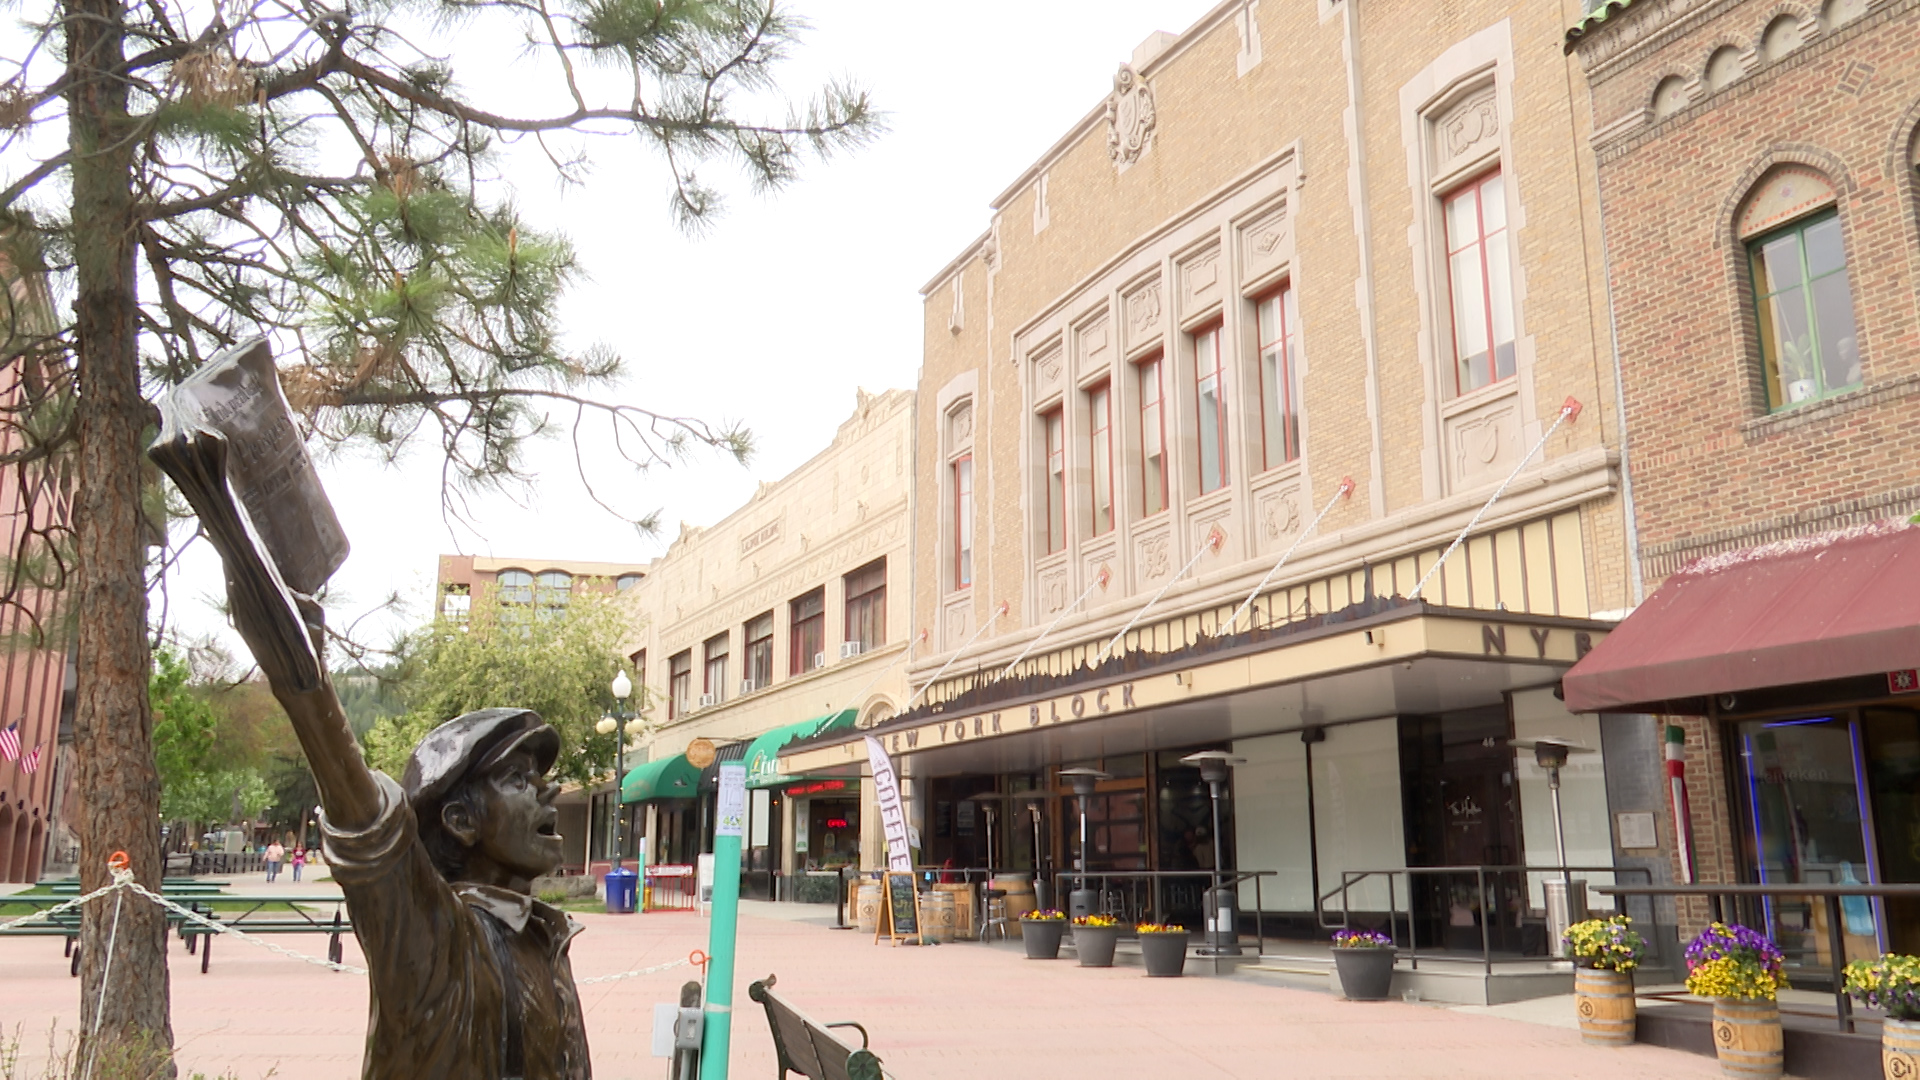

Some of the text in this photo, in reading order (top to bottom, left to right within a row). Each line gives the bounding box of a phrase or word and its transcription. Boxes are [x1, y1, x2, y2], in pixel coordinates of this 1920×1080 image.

[938, 712, 1003, 743] YORK
[1029, 683, 1136, 727] BLOCK
[1482, 736, 1495, 748] 46
[827, 819, 847, 828] OPEN
[874, 767, 910, 870] COFFEE
